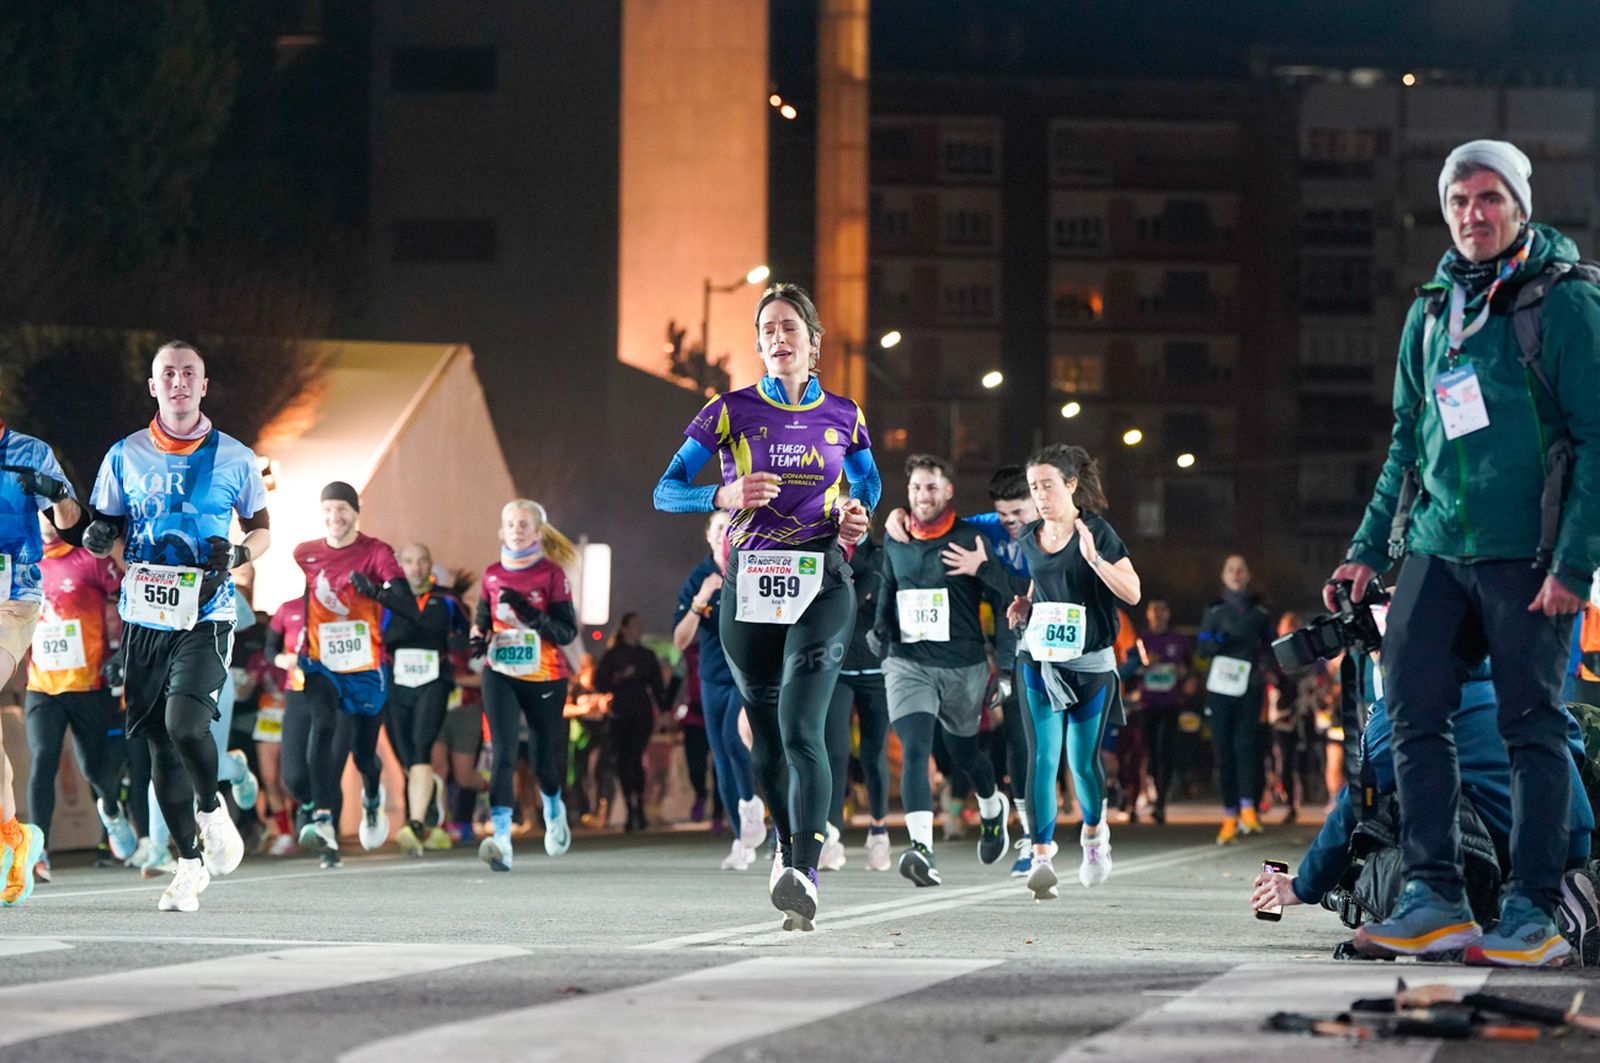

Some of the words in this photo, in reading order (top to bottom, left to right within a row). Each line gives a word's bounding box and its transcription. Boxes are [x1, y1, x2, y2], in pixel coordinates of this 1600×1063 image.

[768, 443, 775, 453] A
[777, 443, 806, 454] FUEGO
[770, 454, 801, 467] TEAM
[746, 566, 763, 574] SAN
[759, 575, 800, 598] 959
[144, 584, 180, 607] 550
[43, 639, 68, 654] 929
[328, 638, 361, 655] 5390
